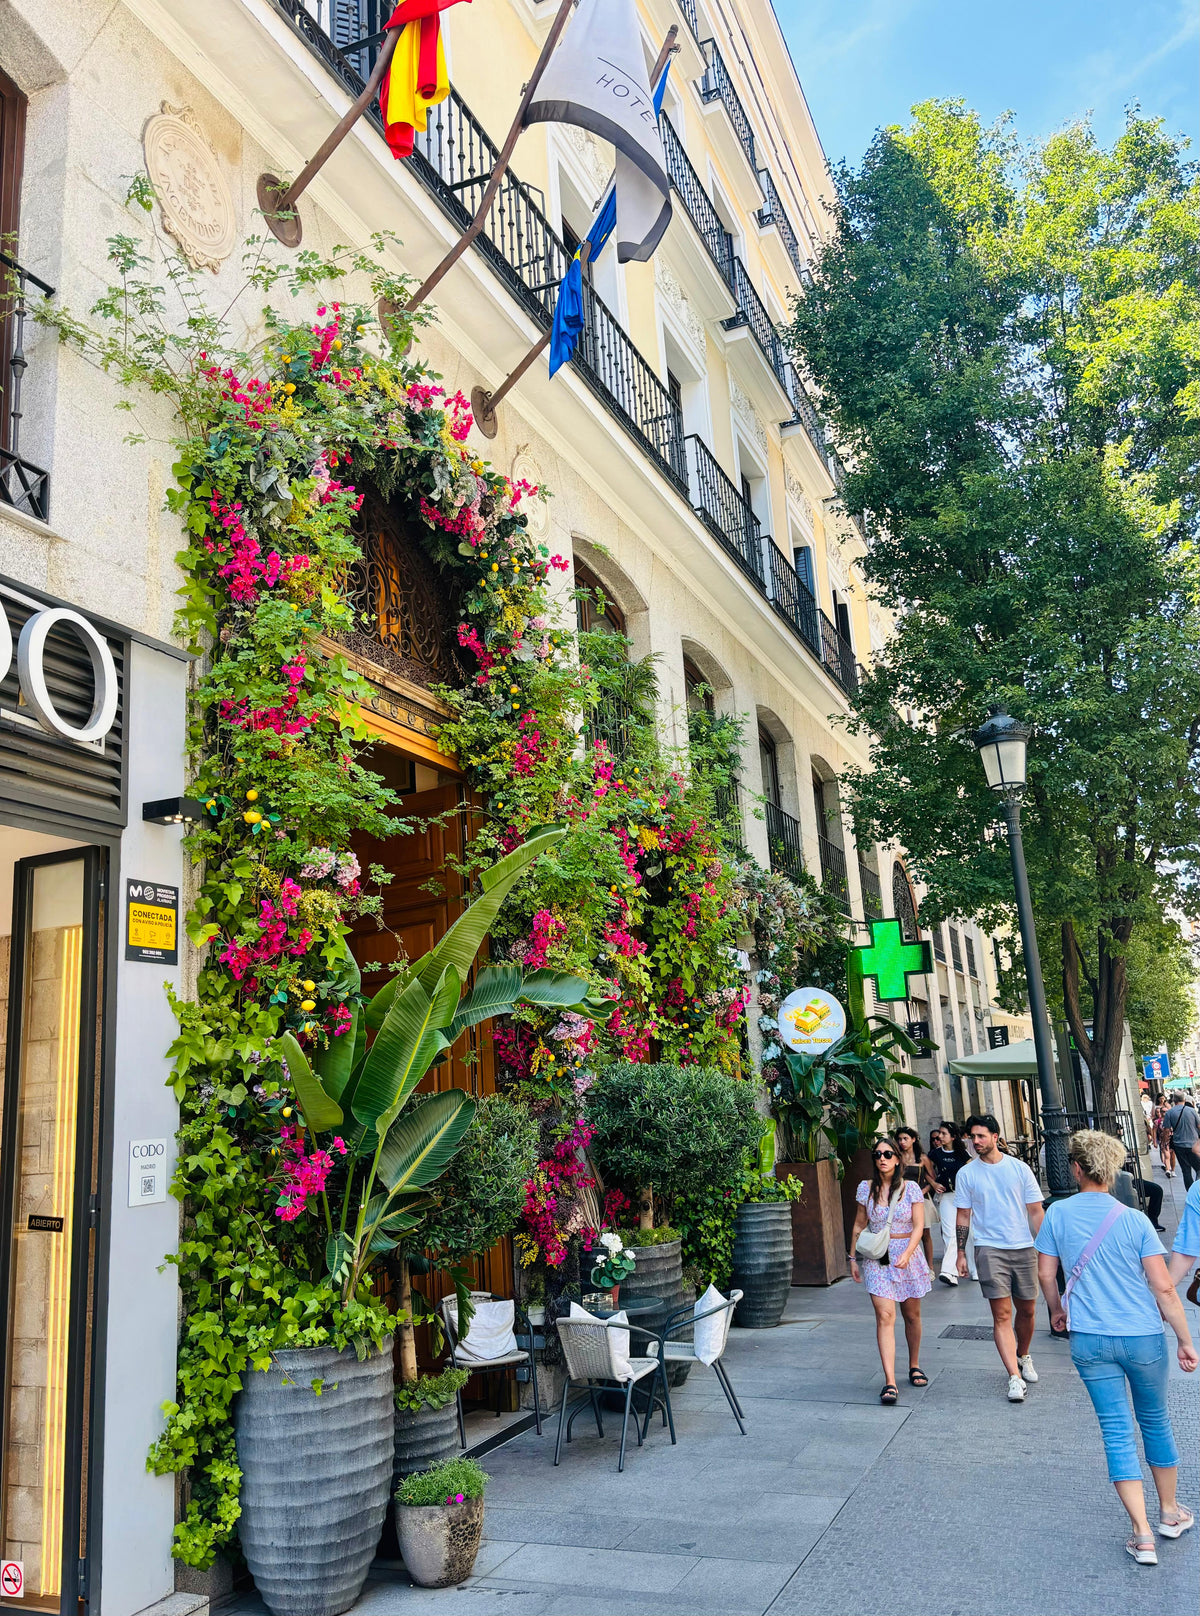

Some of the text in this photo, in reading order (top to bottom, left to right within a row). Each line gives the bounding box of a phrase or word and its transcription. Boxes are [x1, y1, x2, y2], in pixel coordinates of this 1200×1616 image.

[132, 909, 173, 922] CONECTADA
[132, 1143, 165, 1159] CODO
[30, 1218, 61, 1229] ABIERTO
